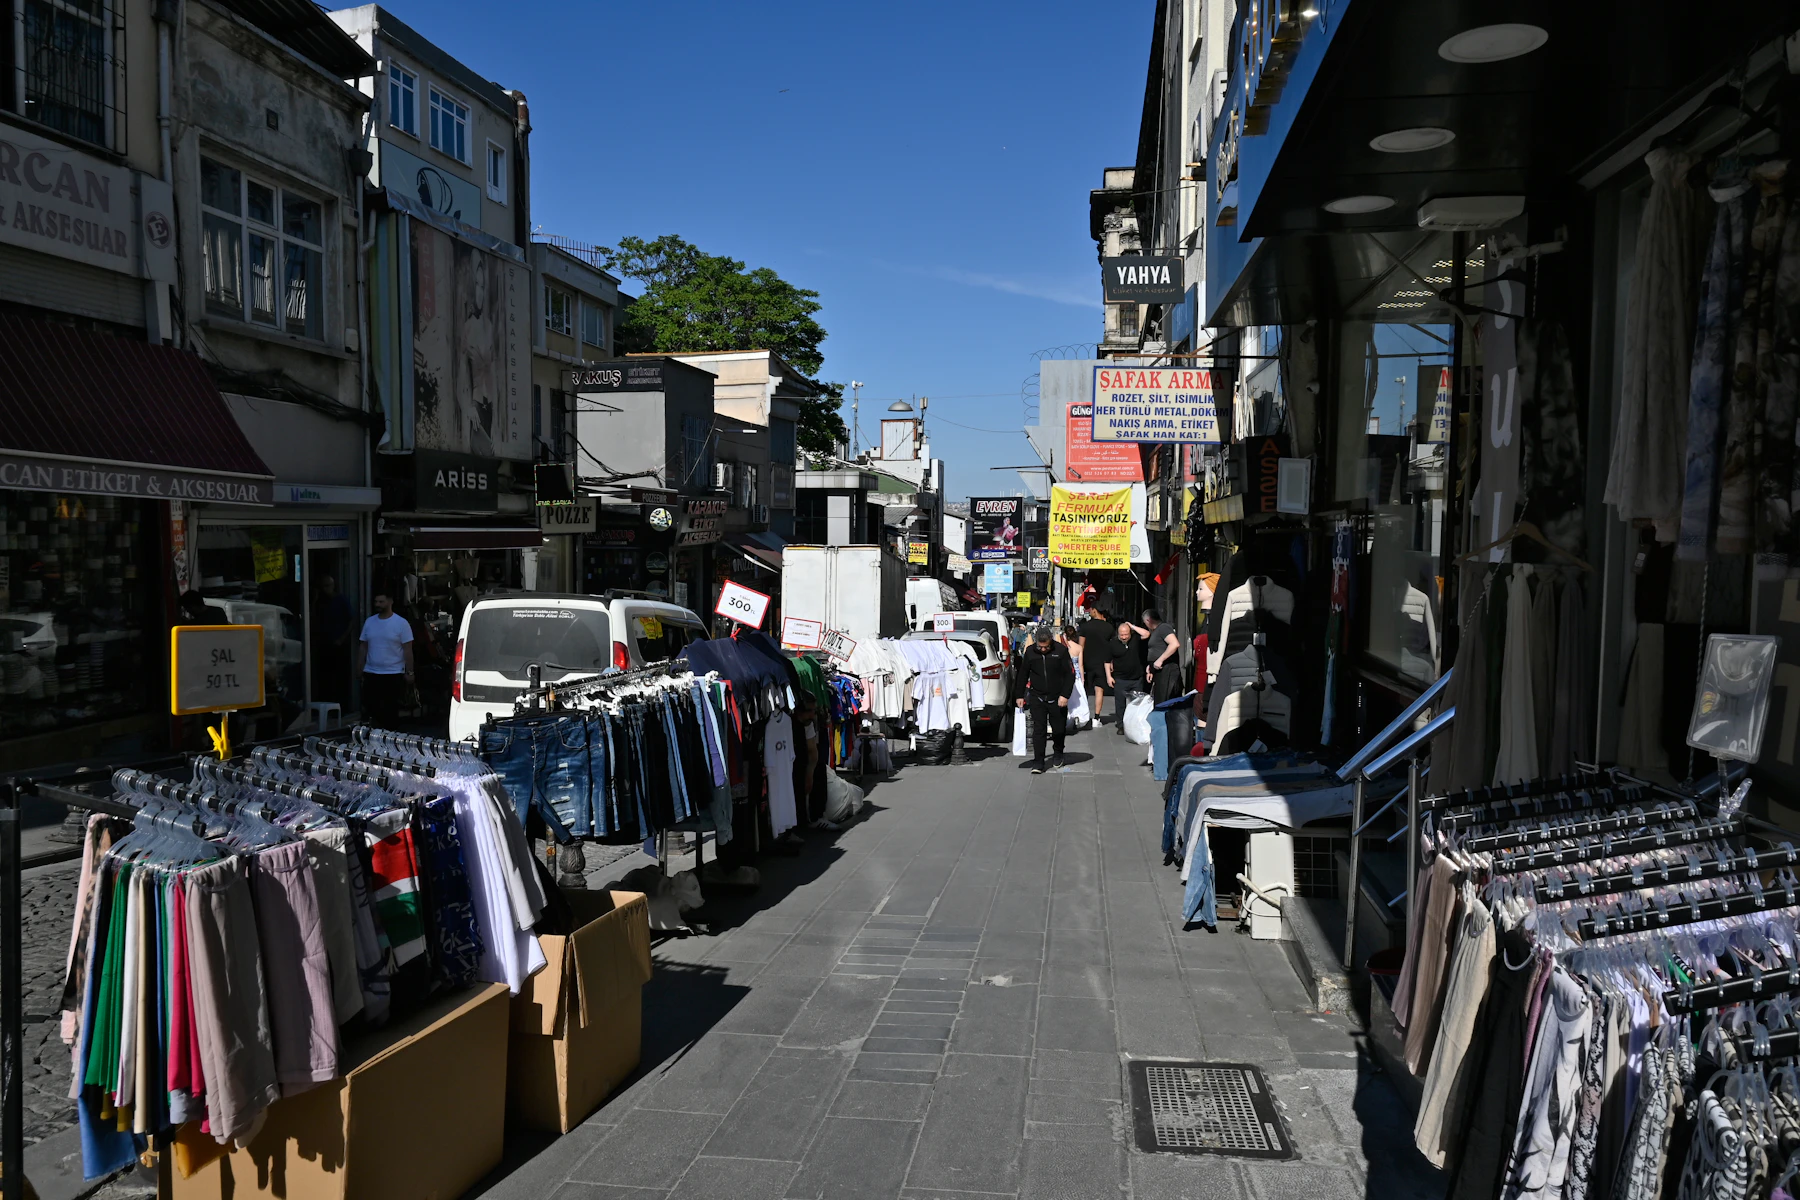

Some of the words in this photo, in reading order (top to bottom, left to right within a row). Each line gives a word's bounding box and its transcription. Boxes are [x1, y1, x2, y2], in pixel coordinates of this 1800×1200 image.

[12, 201, 128, 258] AKSESUAR
[1117, 265, 1171, 285] YAHYA
[1100, 370, 1162, 392] ŞAFAK
[1168, 371, 1225, 390] ARMA
[1112, 393, 1145, 404] ROZET,
[1149, 392, 1171, 405] ŞİLT,
[1175, 392, 1215, 404] İSİMLİK
[1096, 406, 1116, 415] HER
[1120, 404, 1151, 416] TÜRLÜ
[1109, 419, 1141, 429] NAKIŞ
[1144, 419, 1178, 430] ARMA,
[1181, 419, 1215, 430] ETİKET
[1115, 430, 1150, 439] ŞAFAK
[1153, 431, 1176, 439] HAN
[1179, 431, 1207, 439] KAT:1
[60, 465, 141, 494] ETİKET
[146, 475, 164, 495] &
[168, 477, 261, 503] AKSESUAR
[434, 465, 488, 490] ARİSS
[976, 500, 1018, 513] EVREN
[1057, 502, 1125, 514] FERMUAR
[545, 506, 590, 525] POZZE
[1053, 513, 1128, 525] TAŞINIYORUZ
[1060, 525, 1127, 534] ZEYTİNBURNU
[1063, 543, 1098, 551] MERTER
[1099, 543, 1121, 552] ŞUBE
[1062, 557, 1082, 565] 0541
[1084, 558, 1099, 566] 601
[1101, 558, 1112, 566] 53
[1113, 558, 1124, 566] 85
[728, 596, 751, 612] 300
[936, 619, 949, 627] 300
[836, 636, 845, 650] TL
[211, 648, 236, 667] ŞAL
[206, 674, 221, 689] 50
[224, 674, 240, 688] TL
